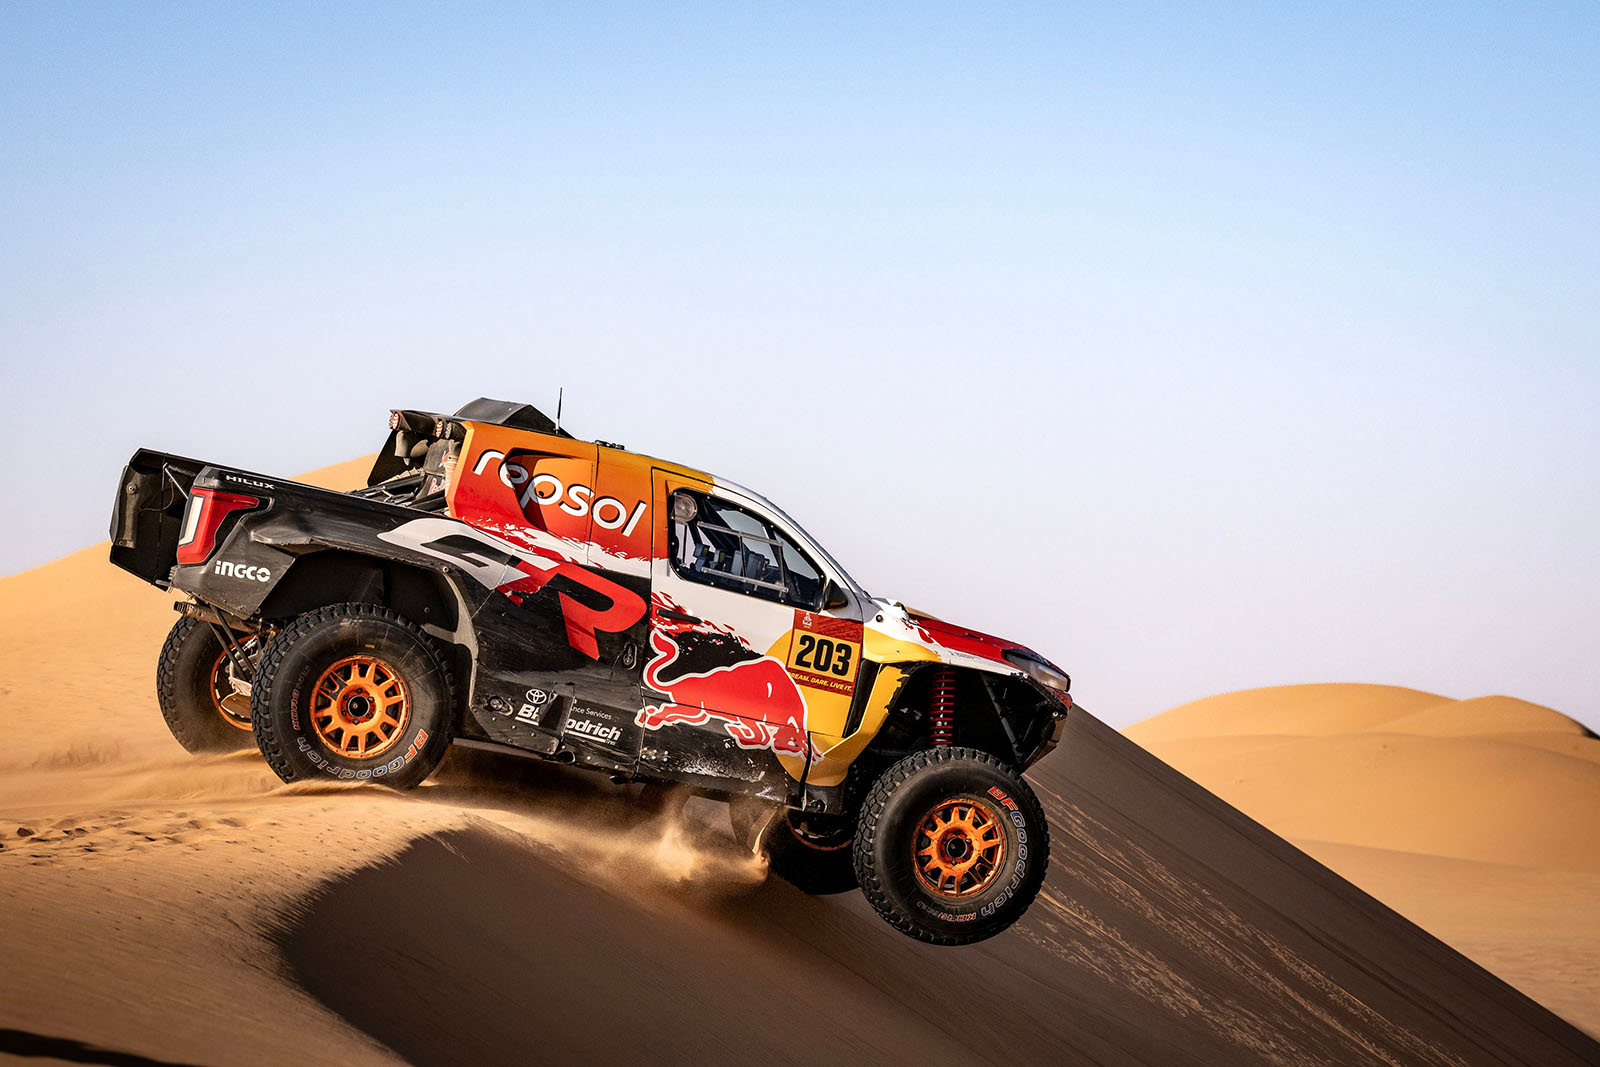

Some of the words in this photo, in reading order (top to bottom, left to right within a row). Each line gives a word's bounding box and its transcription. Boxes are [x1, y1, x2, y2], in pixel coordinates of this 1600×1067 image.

[225, 475, 275, 490] HILUX
[473, 449, 647, 537] repsol
[795, 634, 852, 677] 203
[811, 678, 829, 687] DARE.
[585, 707, 612, 721] Services
[297, 728, 429, 780] BFGoodrich
[981, 786, 1029, 917] BFGoodrich
